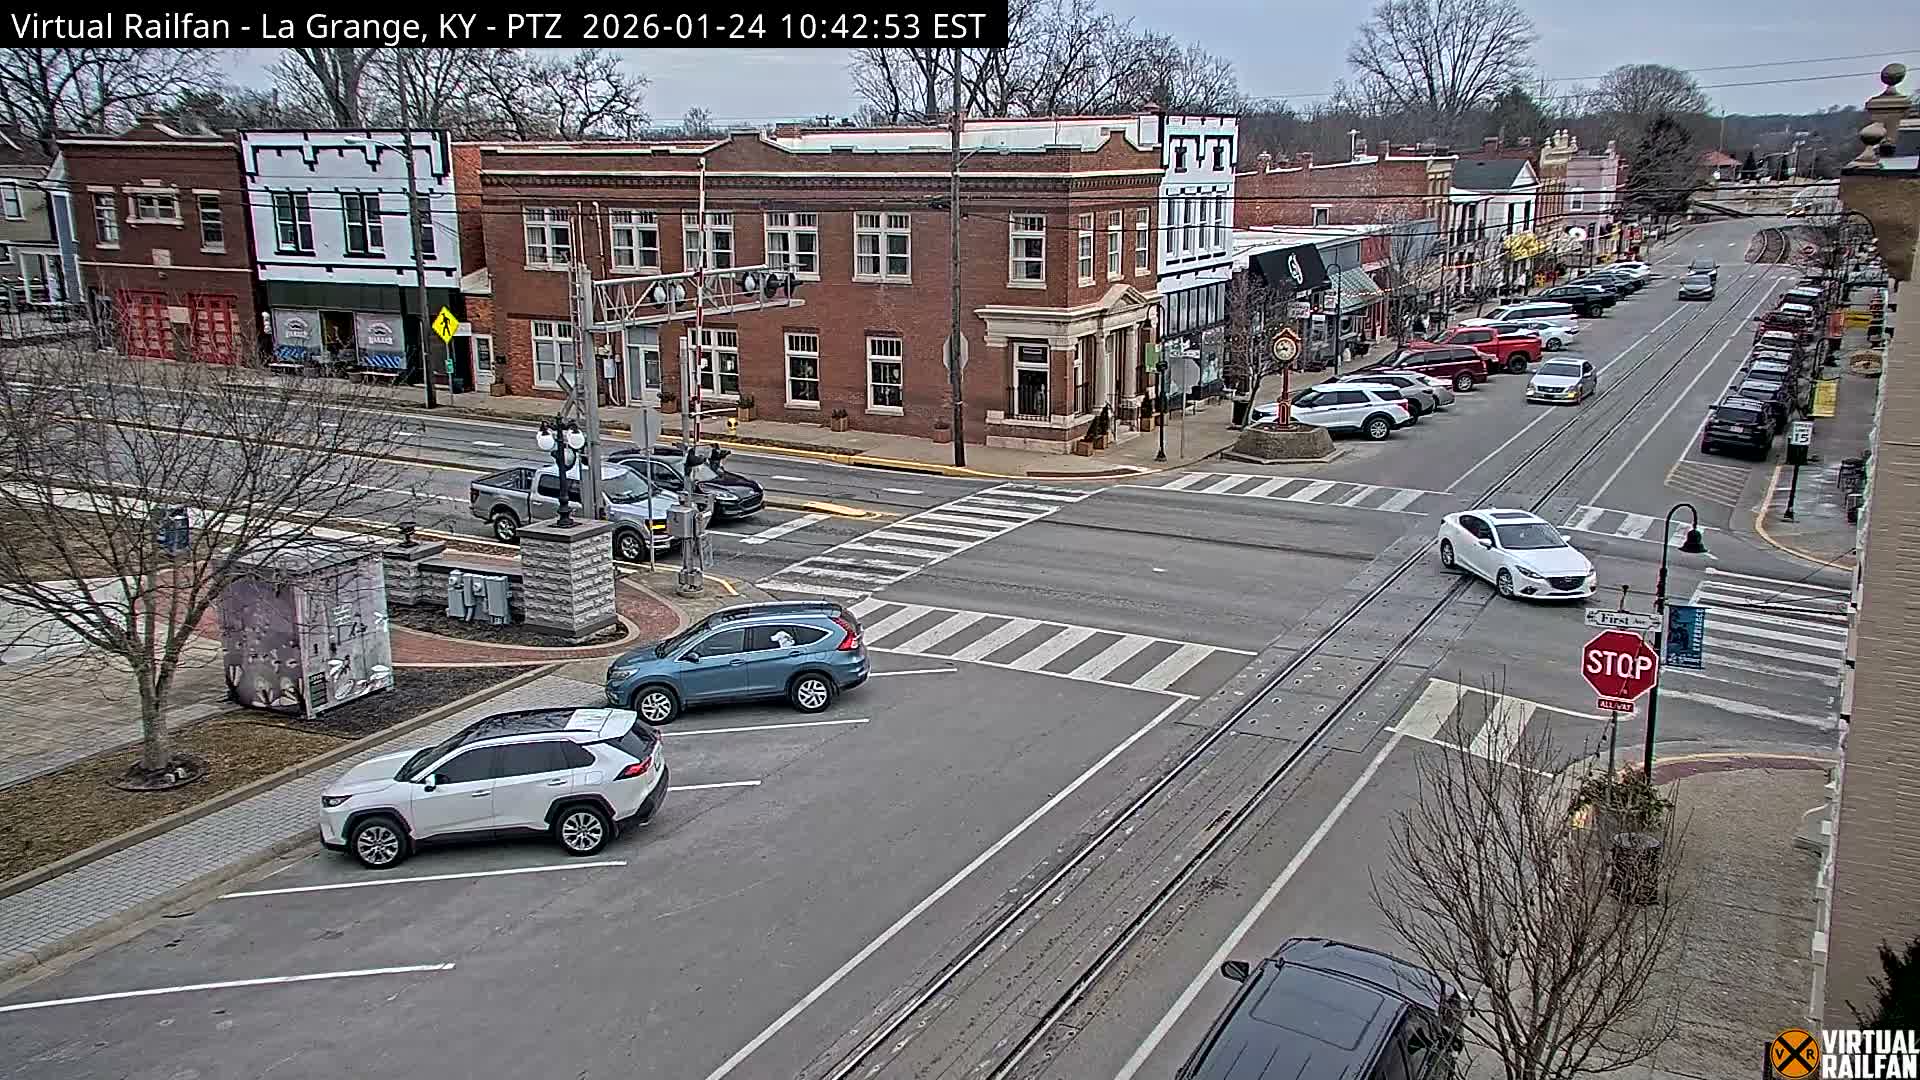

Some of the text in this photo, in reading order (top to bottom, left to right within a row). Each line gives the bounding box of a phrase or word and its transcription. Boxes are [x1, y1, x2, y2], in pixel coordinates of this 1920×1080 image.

[1795, 433, 1808, 443] 15
[1601, 613, 1629, 625] First
[1586, 649, 1653, 680] STOP
[1600, 700, 1632, 711] ALL WAY
